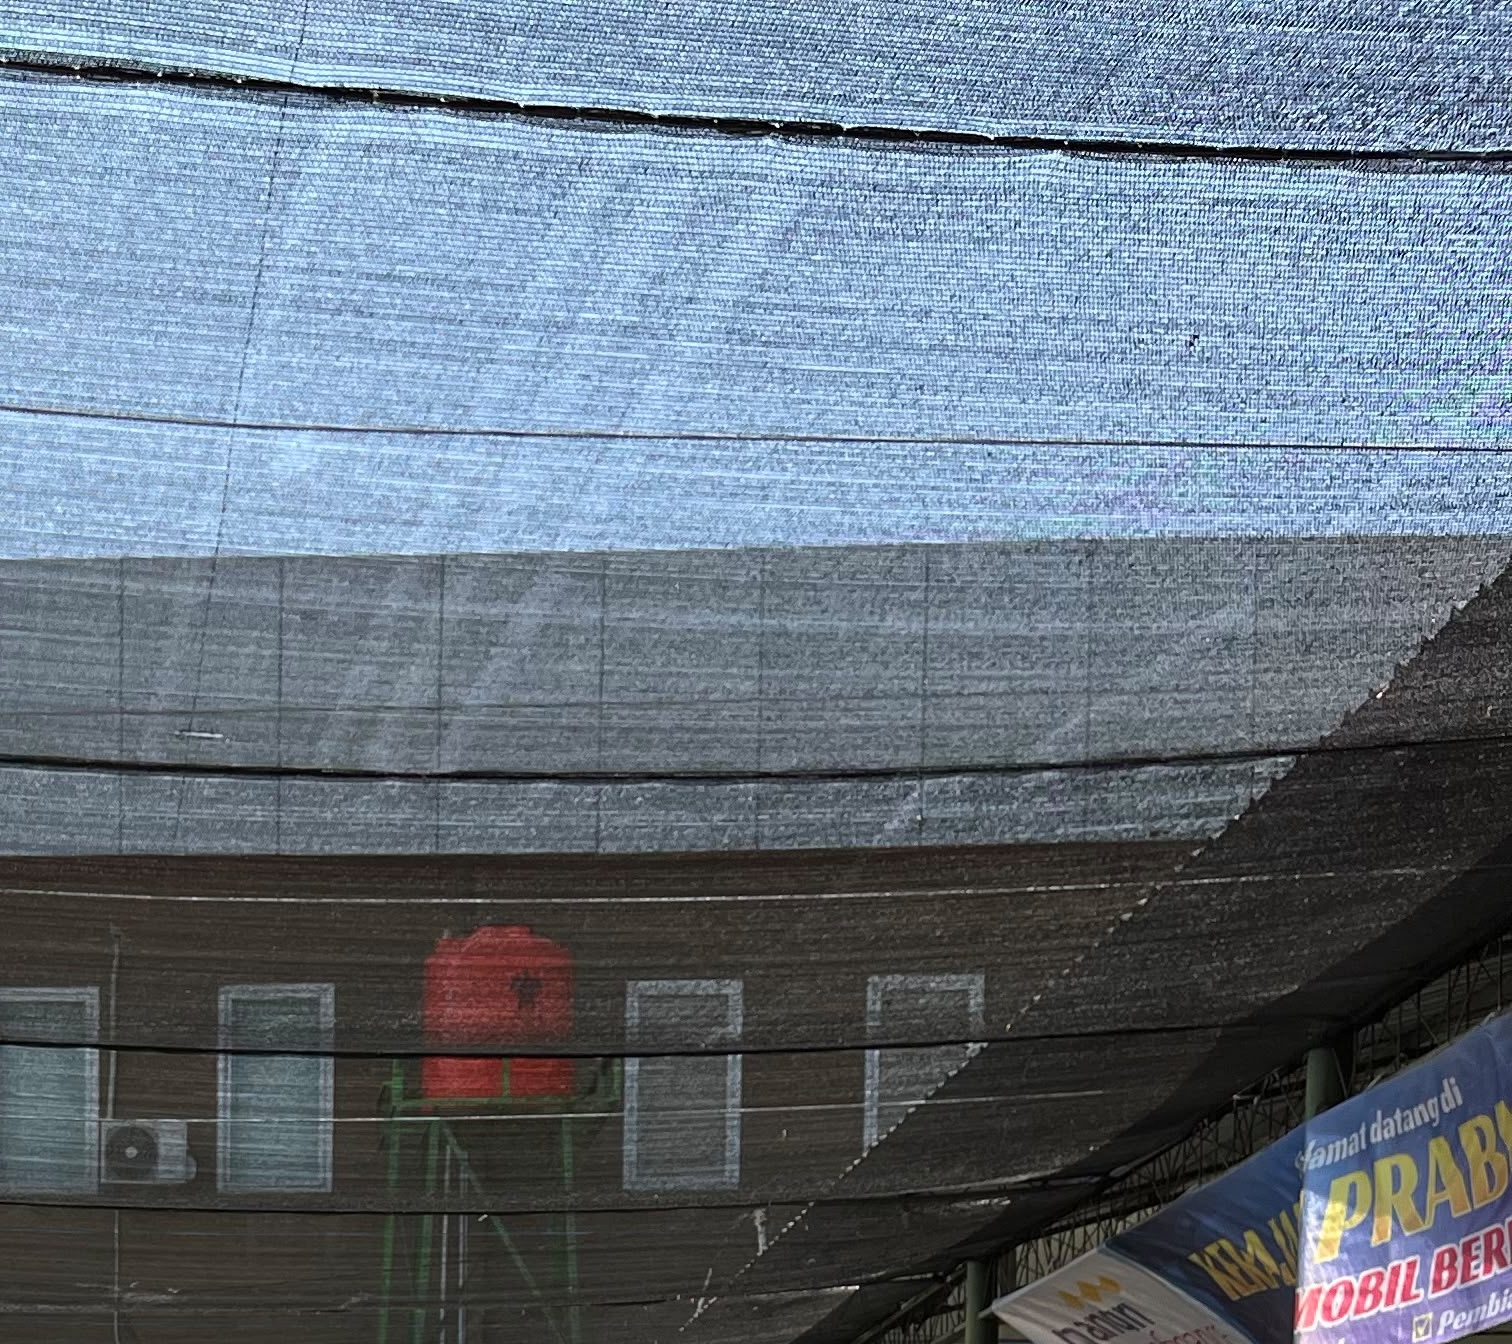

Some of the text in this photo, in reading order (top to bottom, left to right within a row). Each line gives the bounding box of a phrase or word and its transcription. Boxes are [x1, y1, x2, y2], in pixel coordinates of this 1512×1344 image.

[1369, 1097, 1439, 1145] datang
[1439, 1076, 1463, 1114] di
[1294, 1256, 1424, 1333] MOBIL
